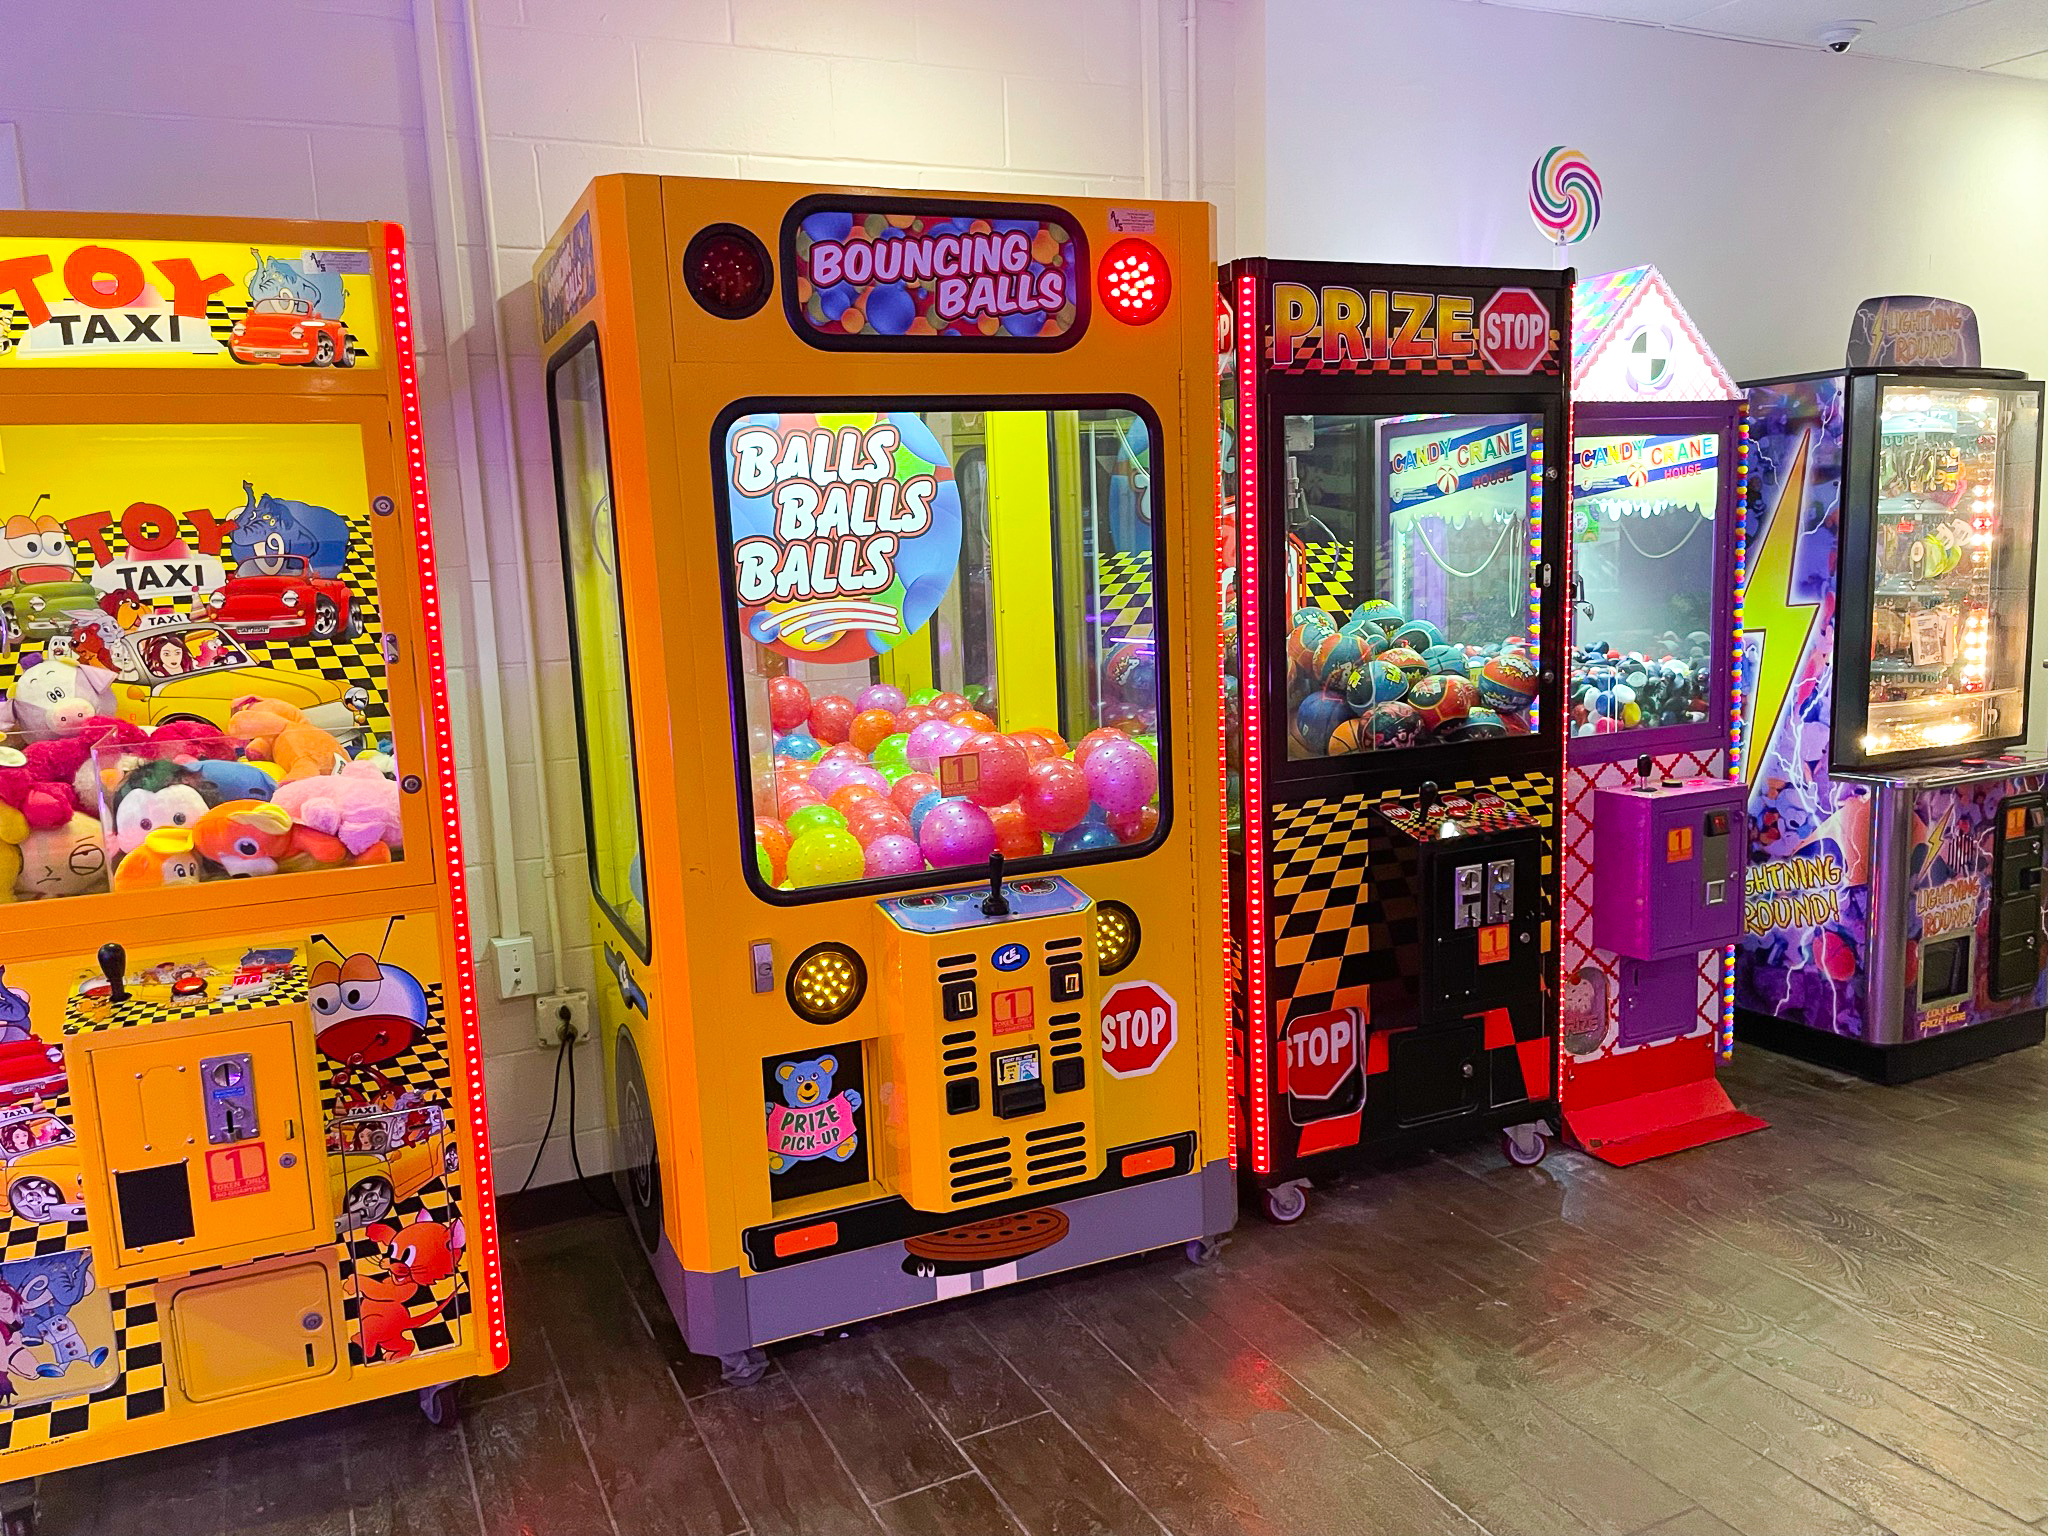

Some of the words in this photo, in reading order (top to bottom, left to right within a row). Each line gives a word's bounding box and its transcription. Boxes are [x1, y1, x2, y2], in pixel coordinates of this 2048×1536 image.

[811, 232, 1031, 287] BOUNCING
[0, 245, 235, 329] TOY
[937, 271, 1066, 319] BALLS
[48, 313, 182, 346] TAXI
[1272, 282, 1475, 365] PRIZE
[1487, 311, 1544, 350] STOP
[735, 427, 899, 495] BALLS
[1391, 437, 1452, 474] CANDY
[1457, 428, 1524, 468] CRANE
[1581, 439, 1646, 469] CANDY
[1651, 437, 1713, 466] CRANE
[1472, 469, 1514, 490] HOUSE
[1664, 463, 1702, 480] HOUSE
[775, 477, 936, 543] BALLS
[64, 502, 240, 568] TOY
[116, 564, 205, 592] TAXI
[735, 534, 898, 604] BALLS
[148, 614, 183, 626] TAXI
[1744, 888, 1840, 937] ROUND!
[999, 947, 1021, 965] ICE
[1005, 992, 1018, 1024] 1
[1101, 1006, 1167, 1053] STOP
[3, 1108, 28, 1119] TAXI
[352, 1106, 377, 1115] TAXI
[780, 1104, 840, 1133] PRIZE
[780, 1127, 840, 1151] PICK-UP
[225, 1149, 243, 1184] 1
